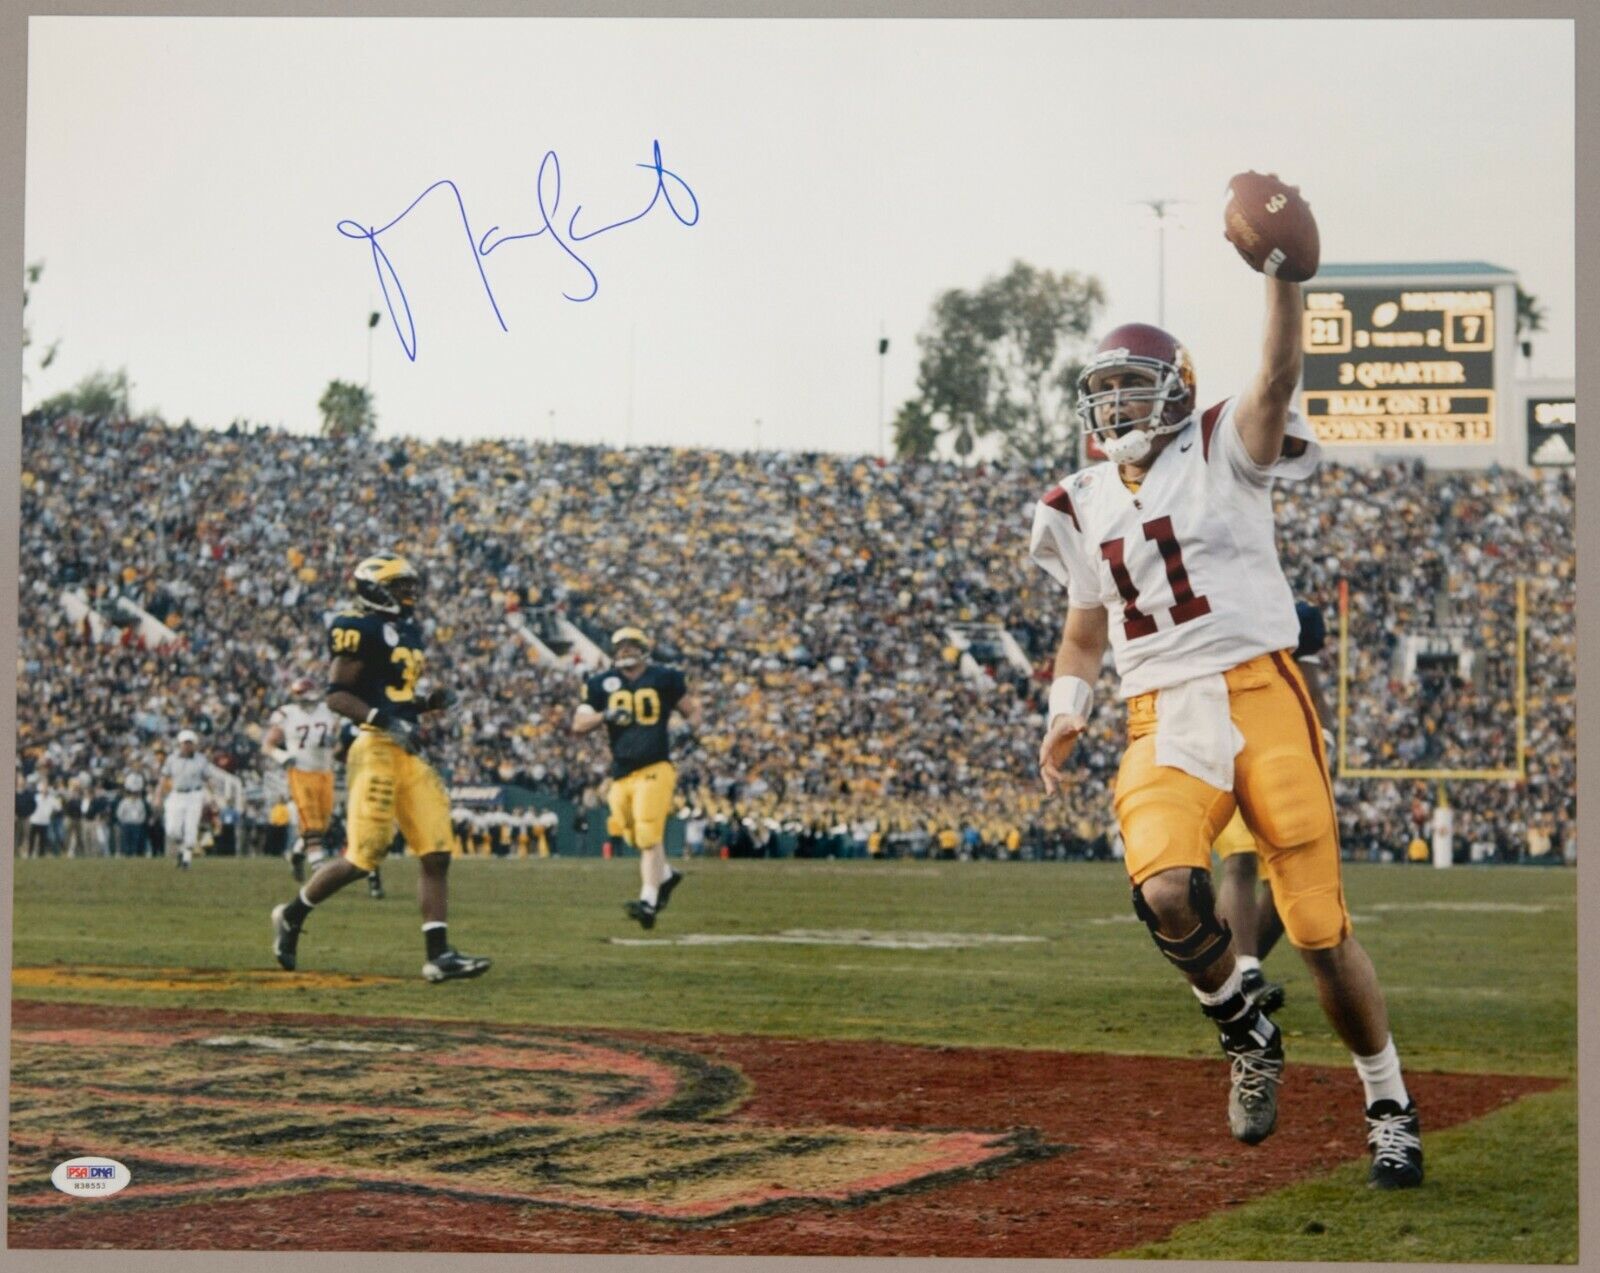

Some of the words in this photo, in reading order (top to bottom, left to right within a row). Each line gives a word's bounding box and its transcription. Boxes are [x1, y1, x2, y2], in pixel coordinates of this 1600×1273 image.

[1311, 319, 1340, 344] 21
[1461, 316, 1481, 342] 7
[1338, 362, 1355, 385] 3
[1356, 361, 1467, 388] QUARTER
[1100, 515, 1212, 641] 11
[331, 627, 361, 652] 30
[296, 721, 328, 749] 77
[68, 1167, 88, 1178] PSA
[90, 1167, 113, 1178] DNA
